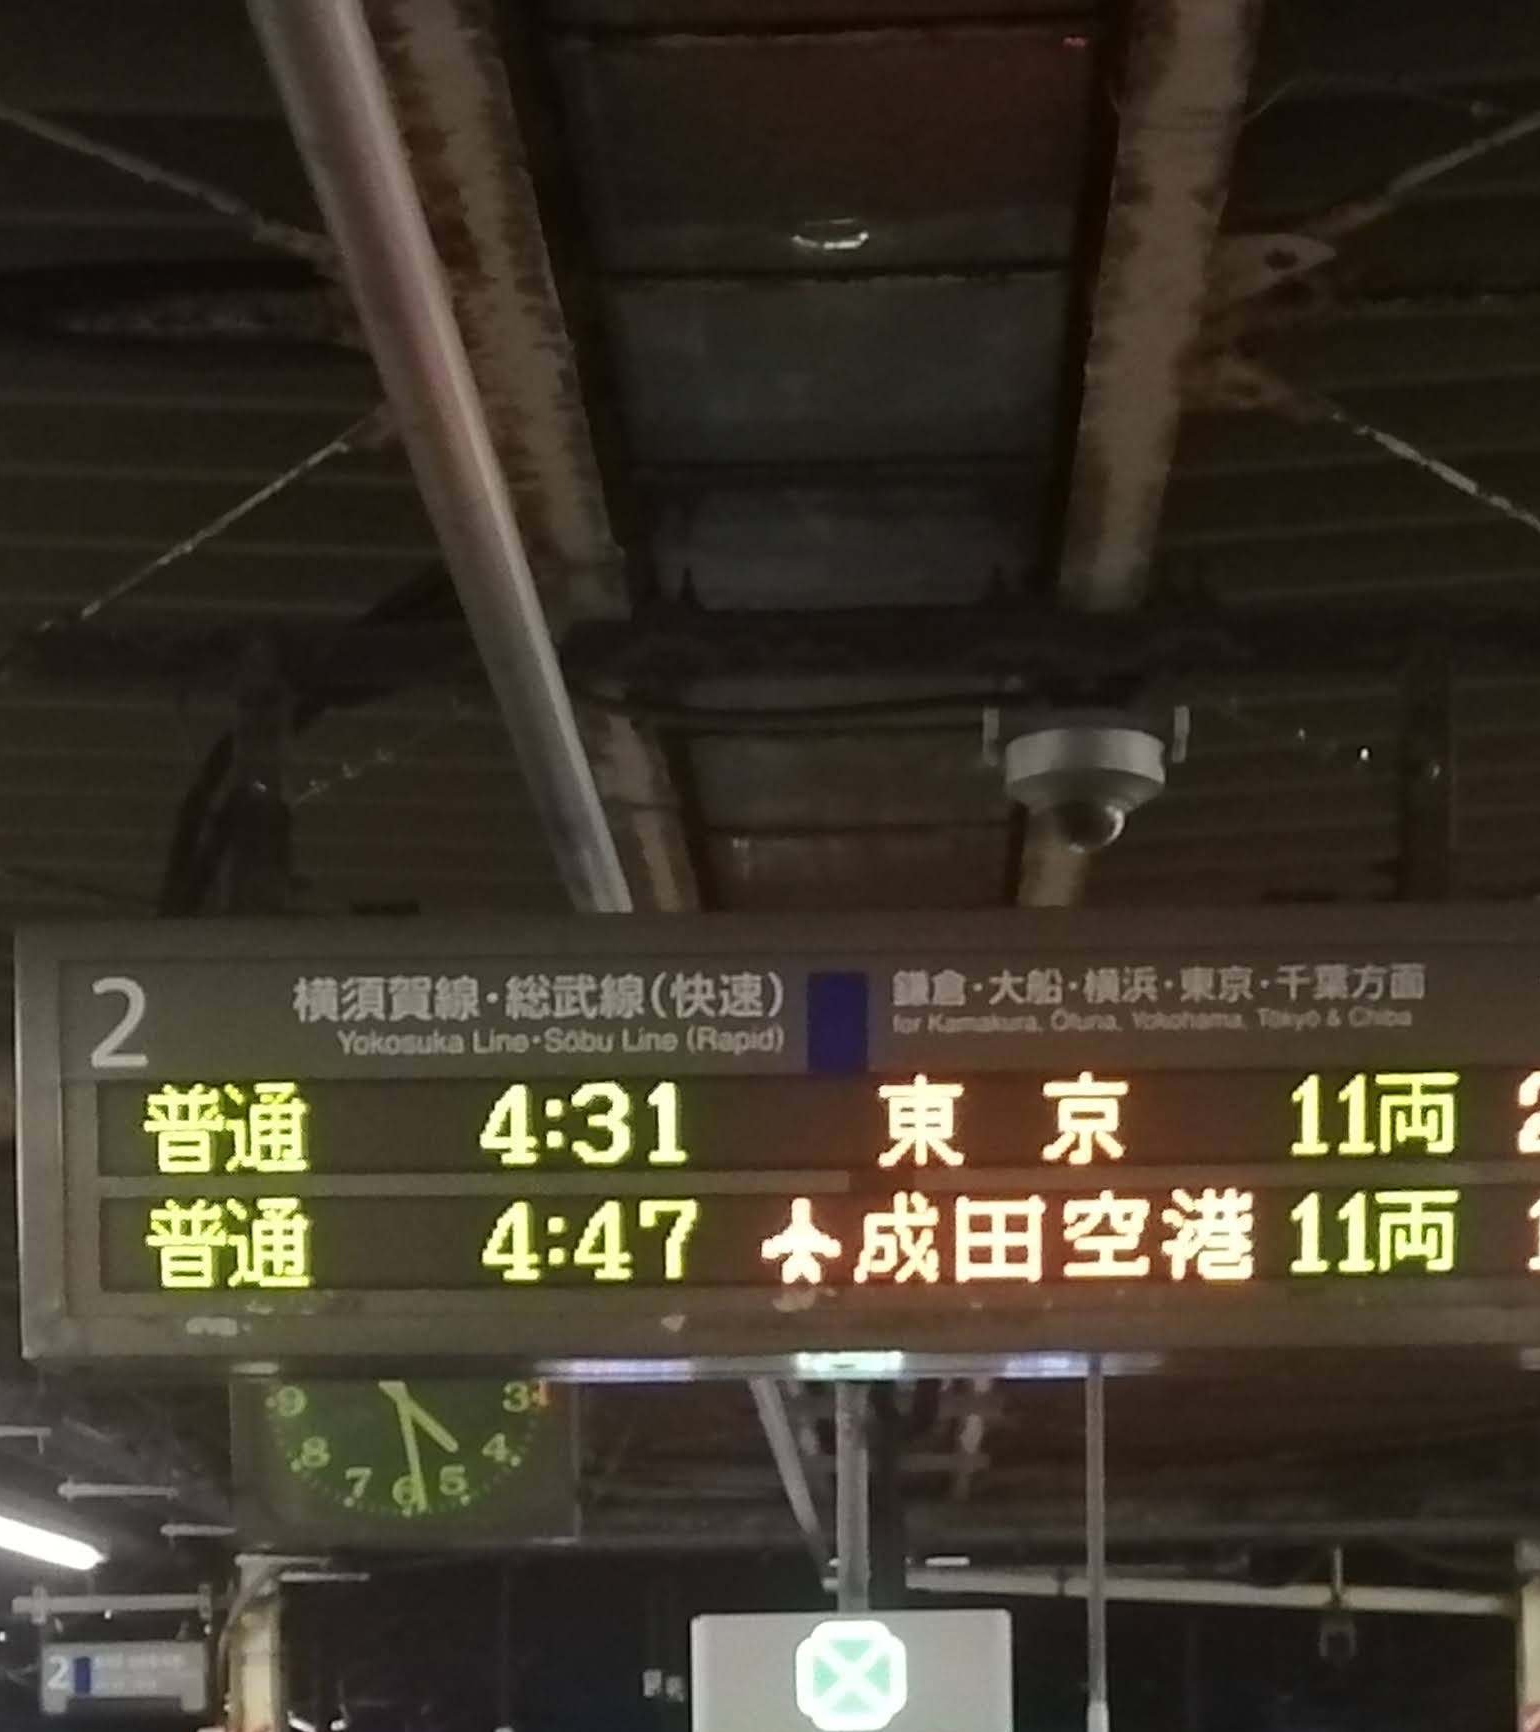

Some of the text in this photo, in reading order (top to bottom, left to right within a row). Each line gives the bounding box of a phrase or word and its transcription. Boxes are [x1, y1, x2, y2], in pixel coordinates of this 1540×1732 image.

[90, 977, 148, 1068] 2
[892, 1013, 922, 1034] for
[1326, 1008, 1341, 1029] &
[337, 1029, 465, 1055] Yokosuka
[622, 1028, 678, 1053] Line
[687, 1025, 785, 1055] (Rapid)
[143, 1081, 311, 1173] 普通
[479, 1081, 690, 1166] 4:31
[1290, 1071, 1460, 1157] 11両
[145, 1197, 313, 1290] 普通
[481, 1199, 701, 1283] 4:47
[853, 1188, 1255, 1284] 成田空港
[1289, 1188, 1460, 1274] 11両
[502, 1380, 530, 1413] 3
[301, 1436, 331, 1468] 8
[482, 1433, 508, 1463] 4
[345, 1467, 372, 1499] 7
[439, 1465, 468, 1496] 5
[47, 1656, 69, 1689] 2
